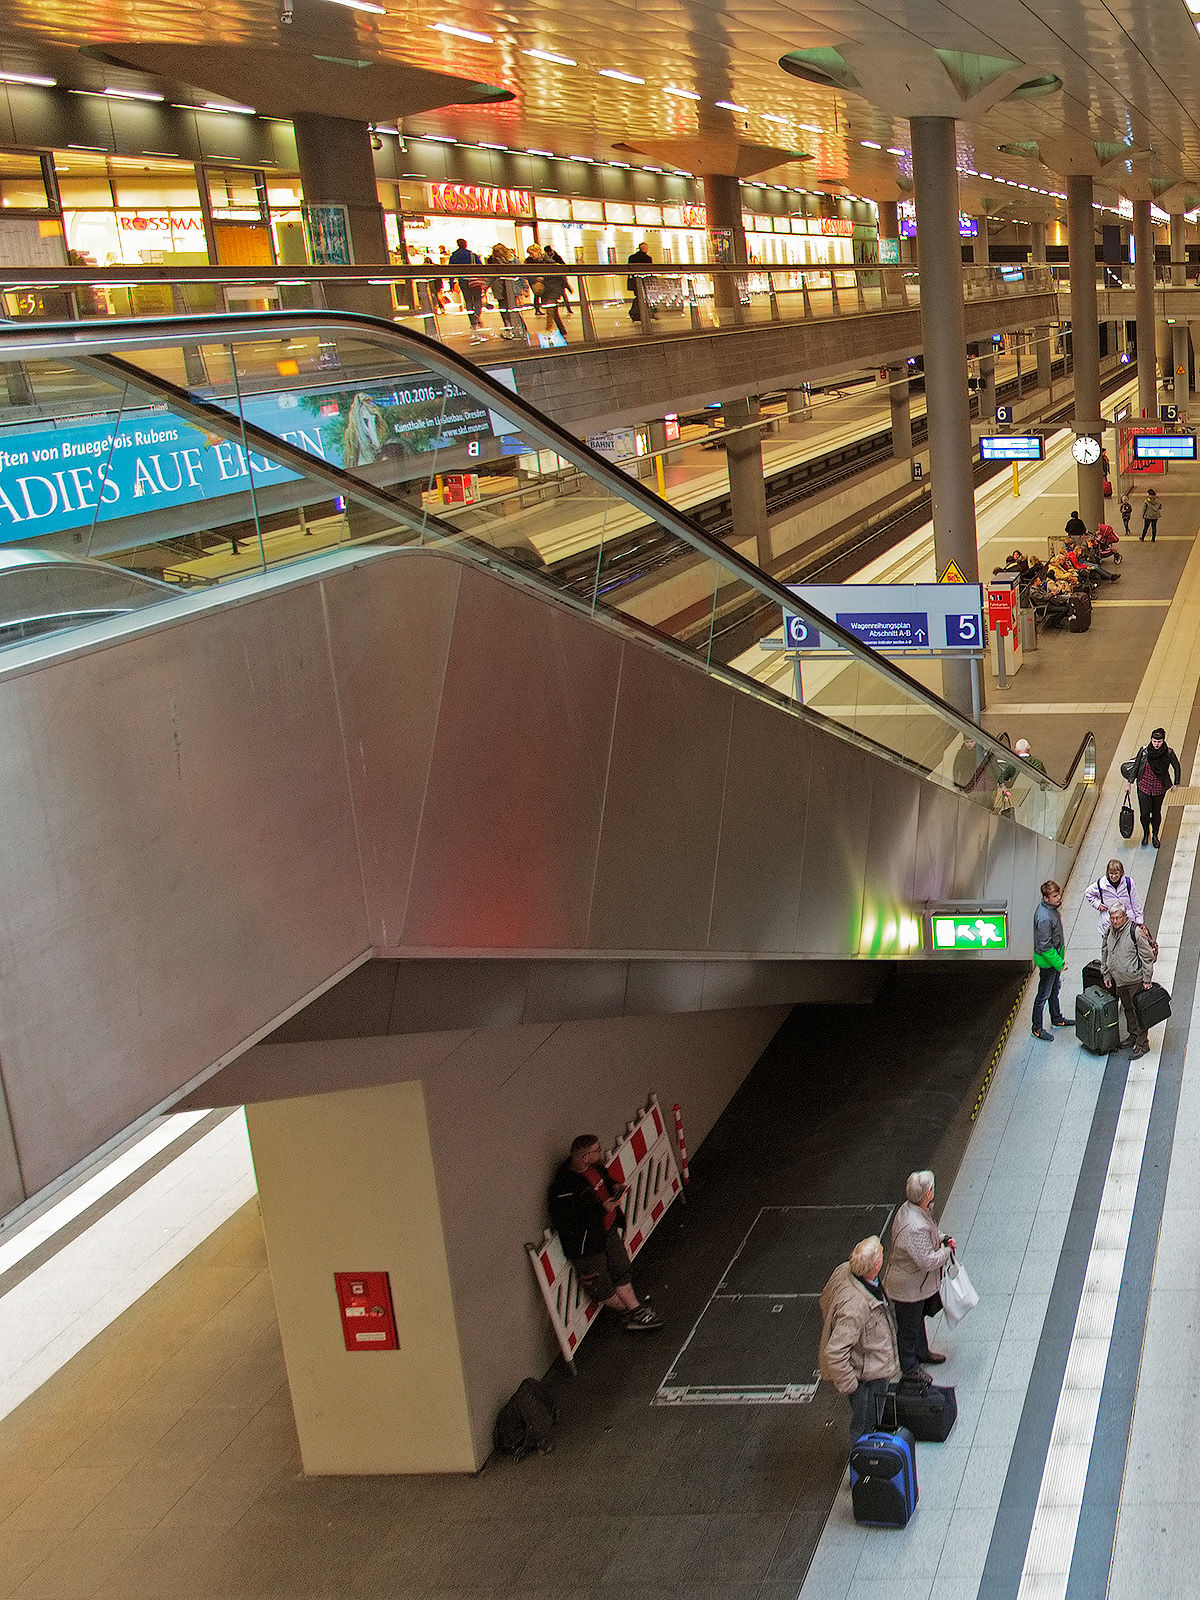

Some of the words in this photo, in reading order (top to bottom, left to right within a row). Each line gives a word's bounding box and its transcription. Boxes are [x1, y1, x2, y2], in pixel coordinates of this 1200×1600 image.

[430, 184, 532, 214] ROSSMANN
[393, 386, 436, 406] 1.10.2016
[997, 406, 1007, 421] 6
[1167, 405, 1177, 419] 5
[394, 419, 425, 433] Kunsthalle
[32, 447, 59, 463] von
[135, 428, 179, 446] Rubens
[132, 447, 204, 499] AUF
[790, 616, 808, 642] 6
[850, 622, 911, 631] Wagenreihungsplan
[869, 630, 898, 638] Abschnitt
[959, 614, 976, 640] 5
